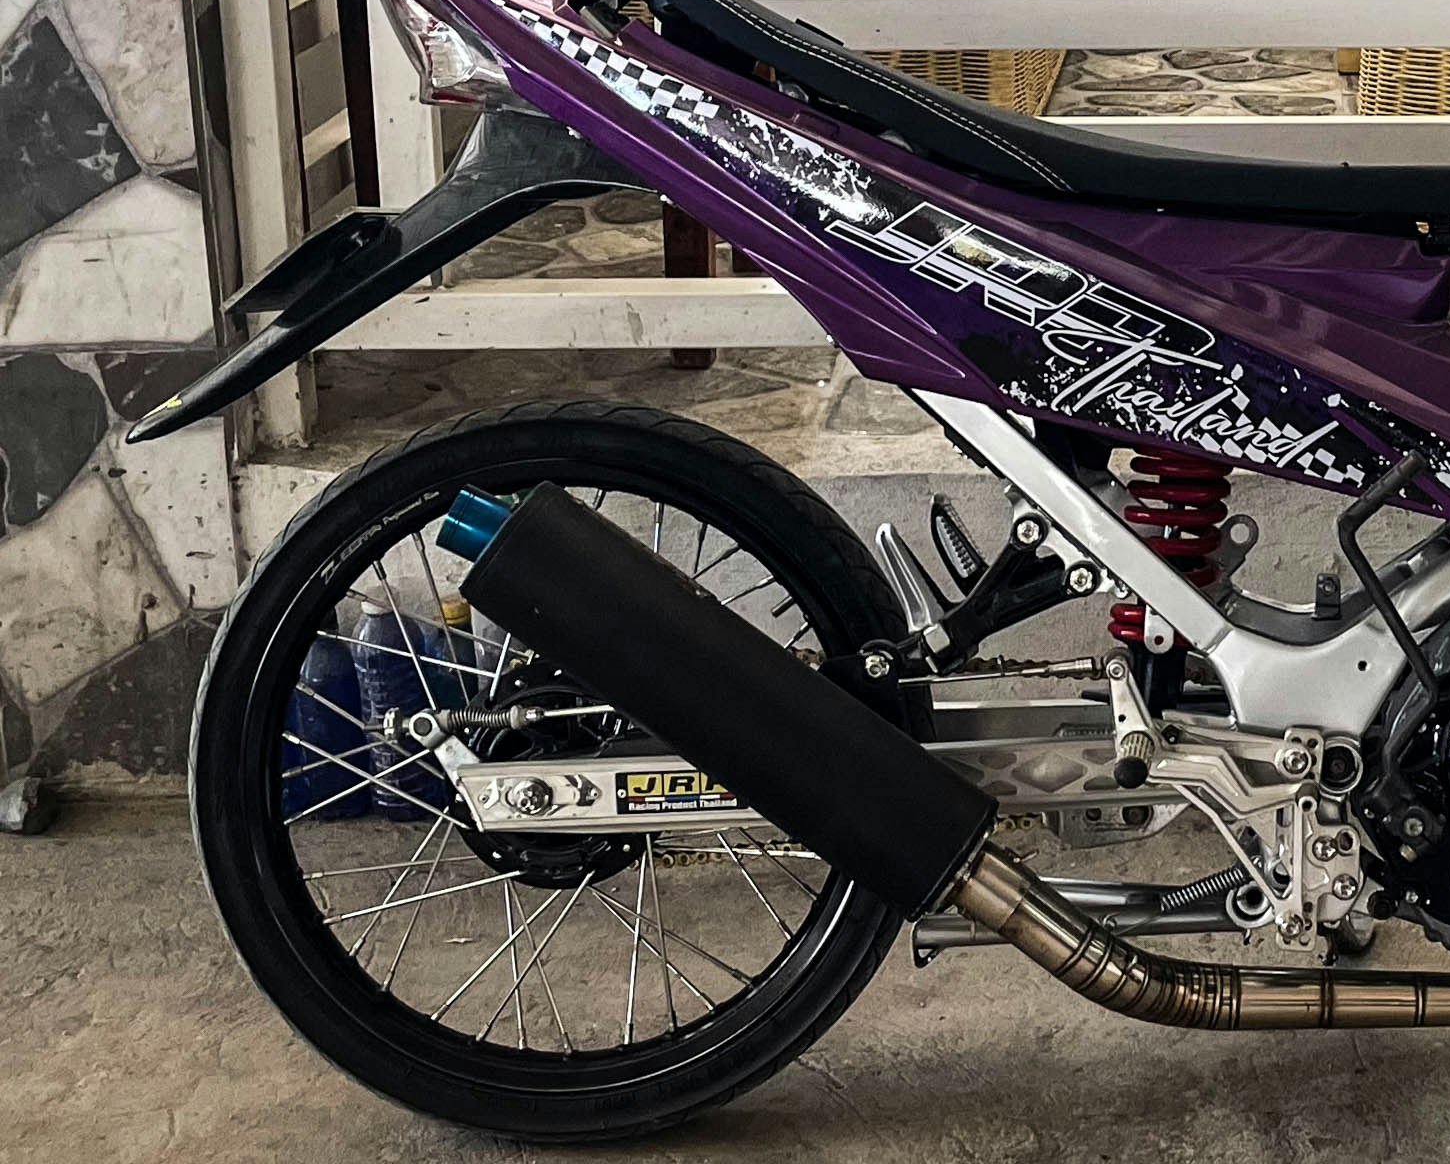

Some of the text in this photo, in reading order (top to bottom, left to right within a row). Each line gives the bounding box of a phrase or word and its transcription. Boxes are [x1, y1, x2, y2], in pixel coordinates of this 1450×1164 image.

[1042, 328, 1340, 469] Thailand
[628, 798, 738, 811] Racing Product Thailand
